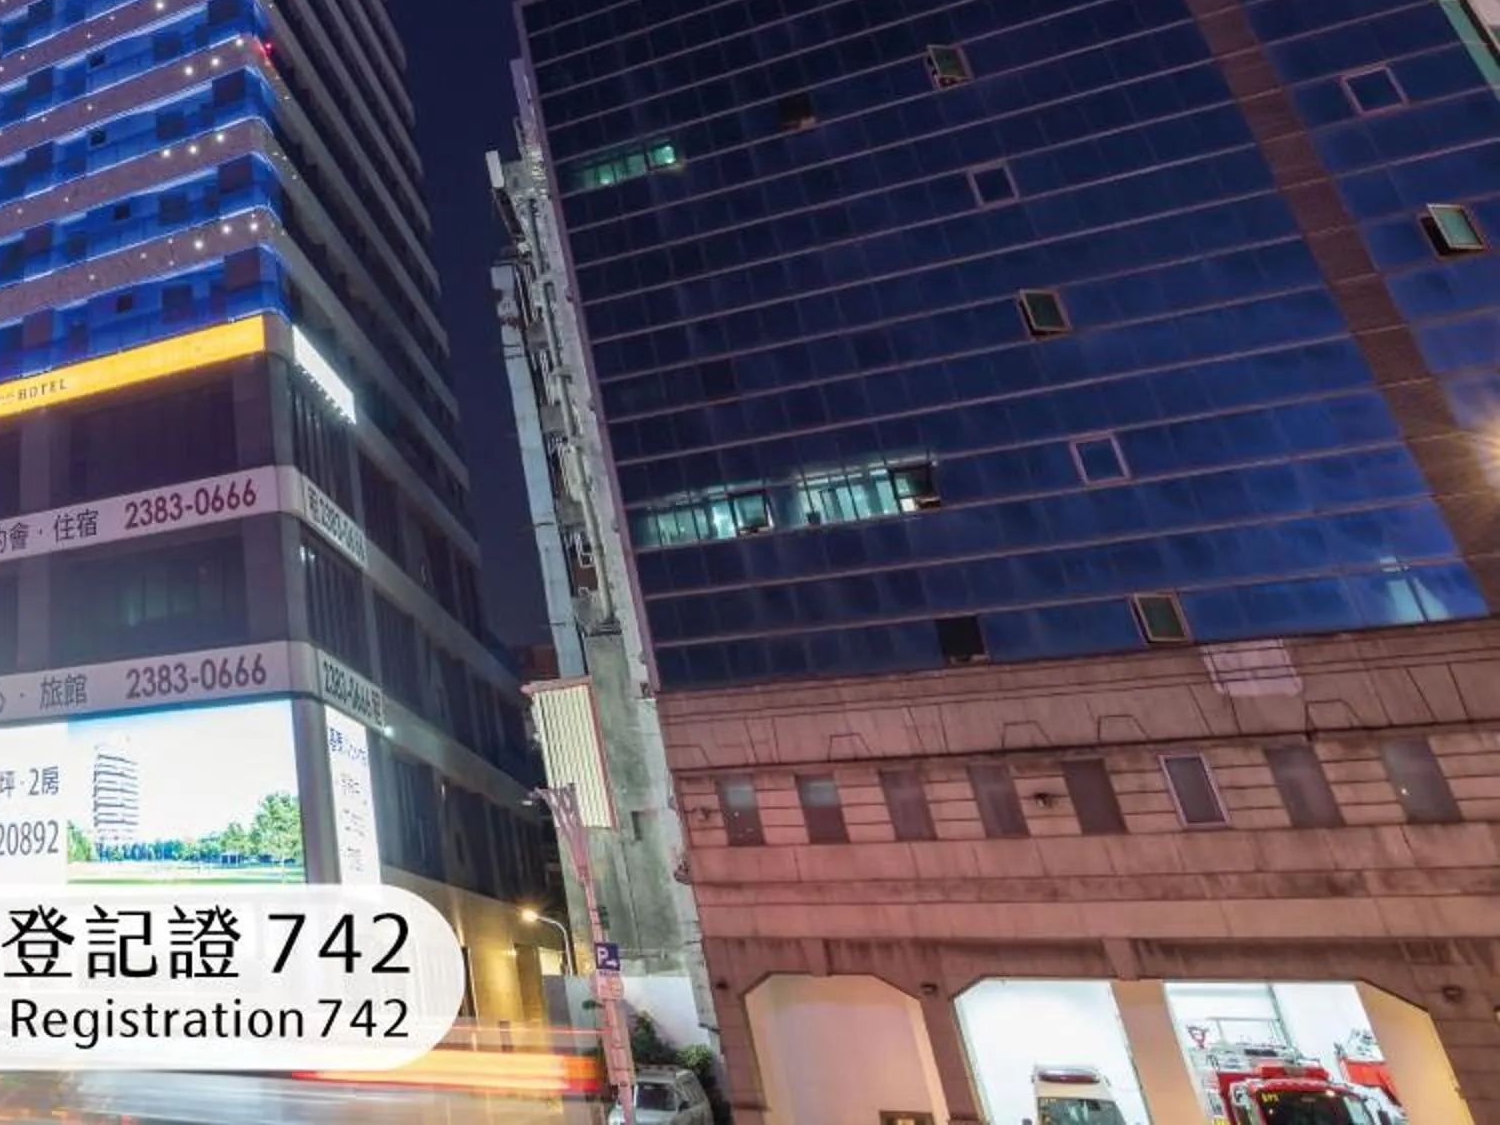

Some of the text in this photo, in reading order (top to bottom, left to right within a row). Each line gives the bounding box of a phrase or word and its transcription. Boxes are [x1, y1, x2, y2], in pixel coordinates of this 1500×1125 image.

[16, 378, 68, 400] HOTEL
[124, 479, 257, 530] 2383-0666
[126, 653, 267, 700] 2383-0666
